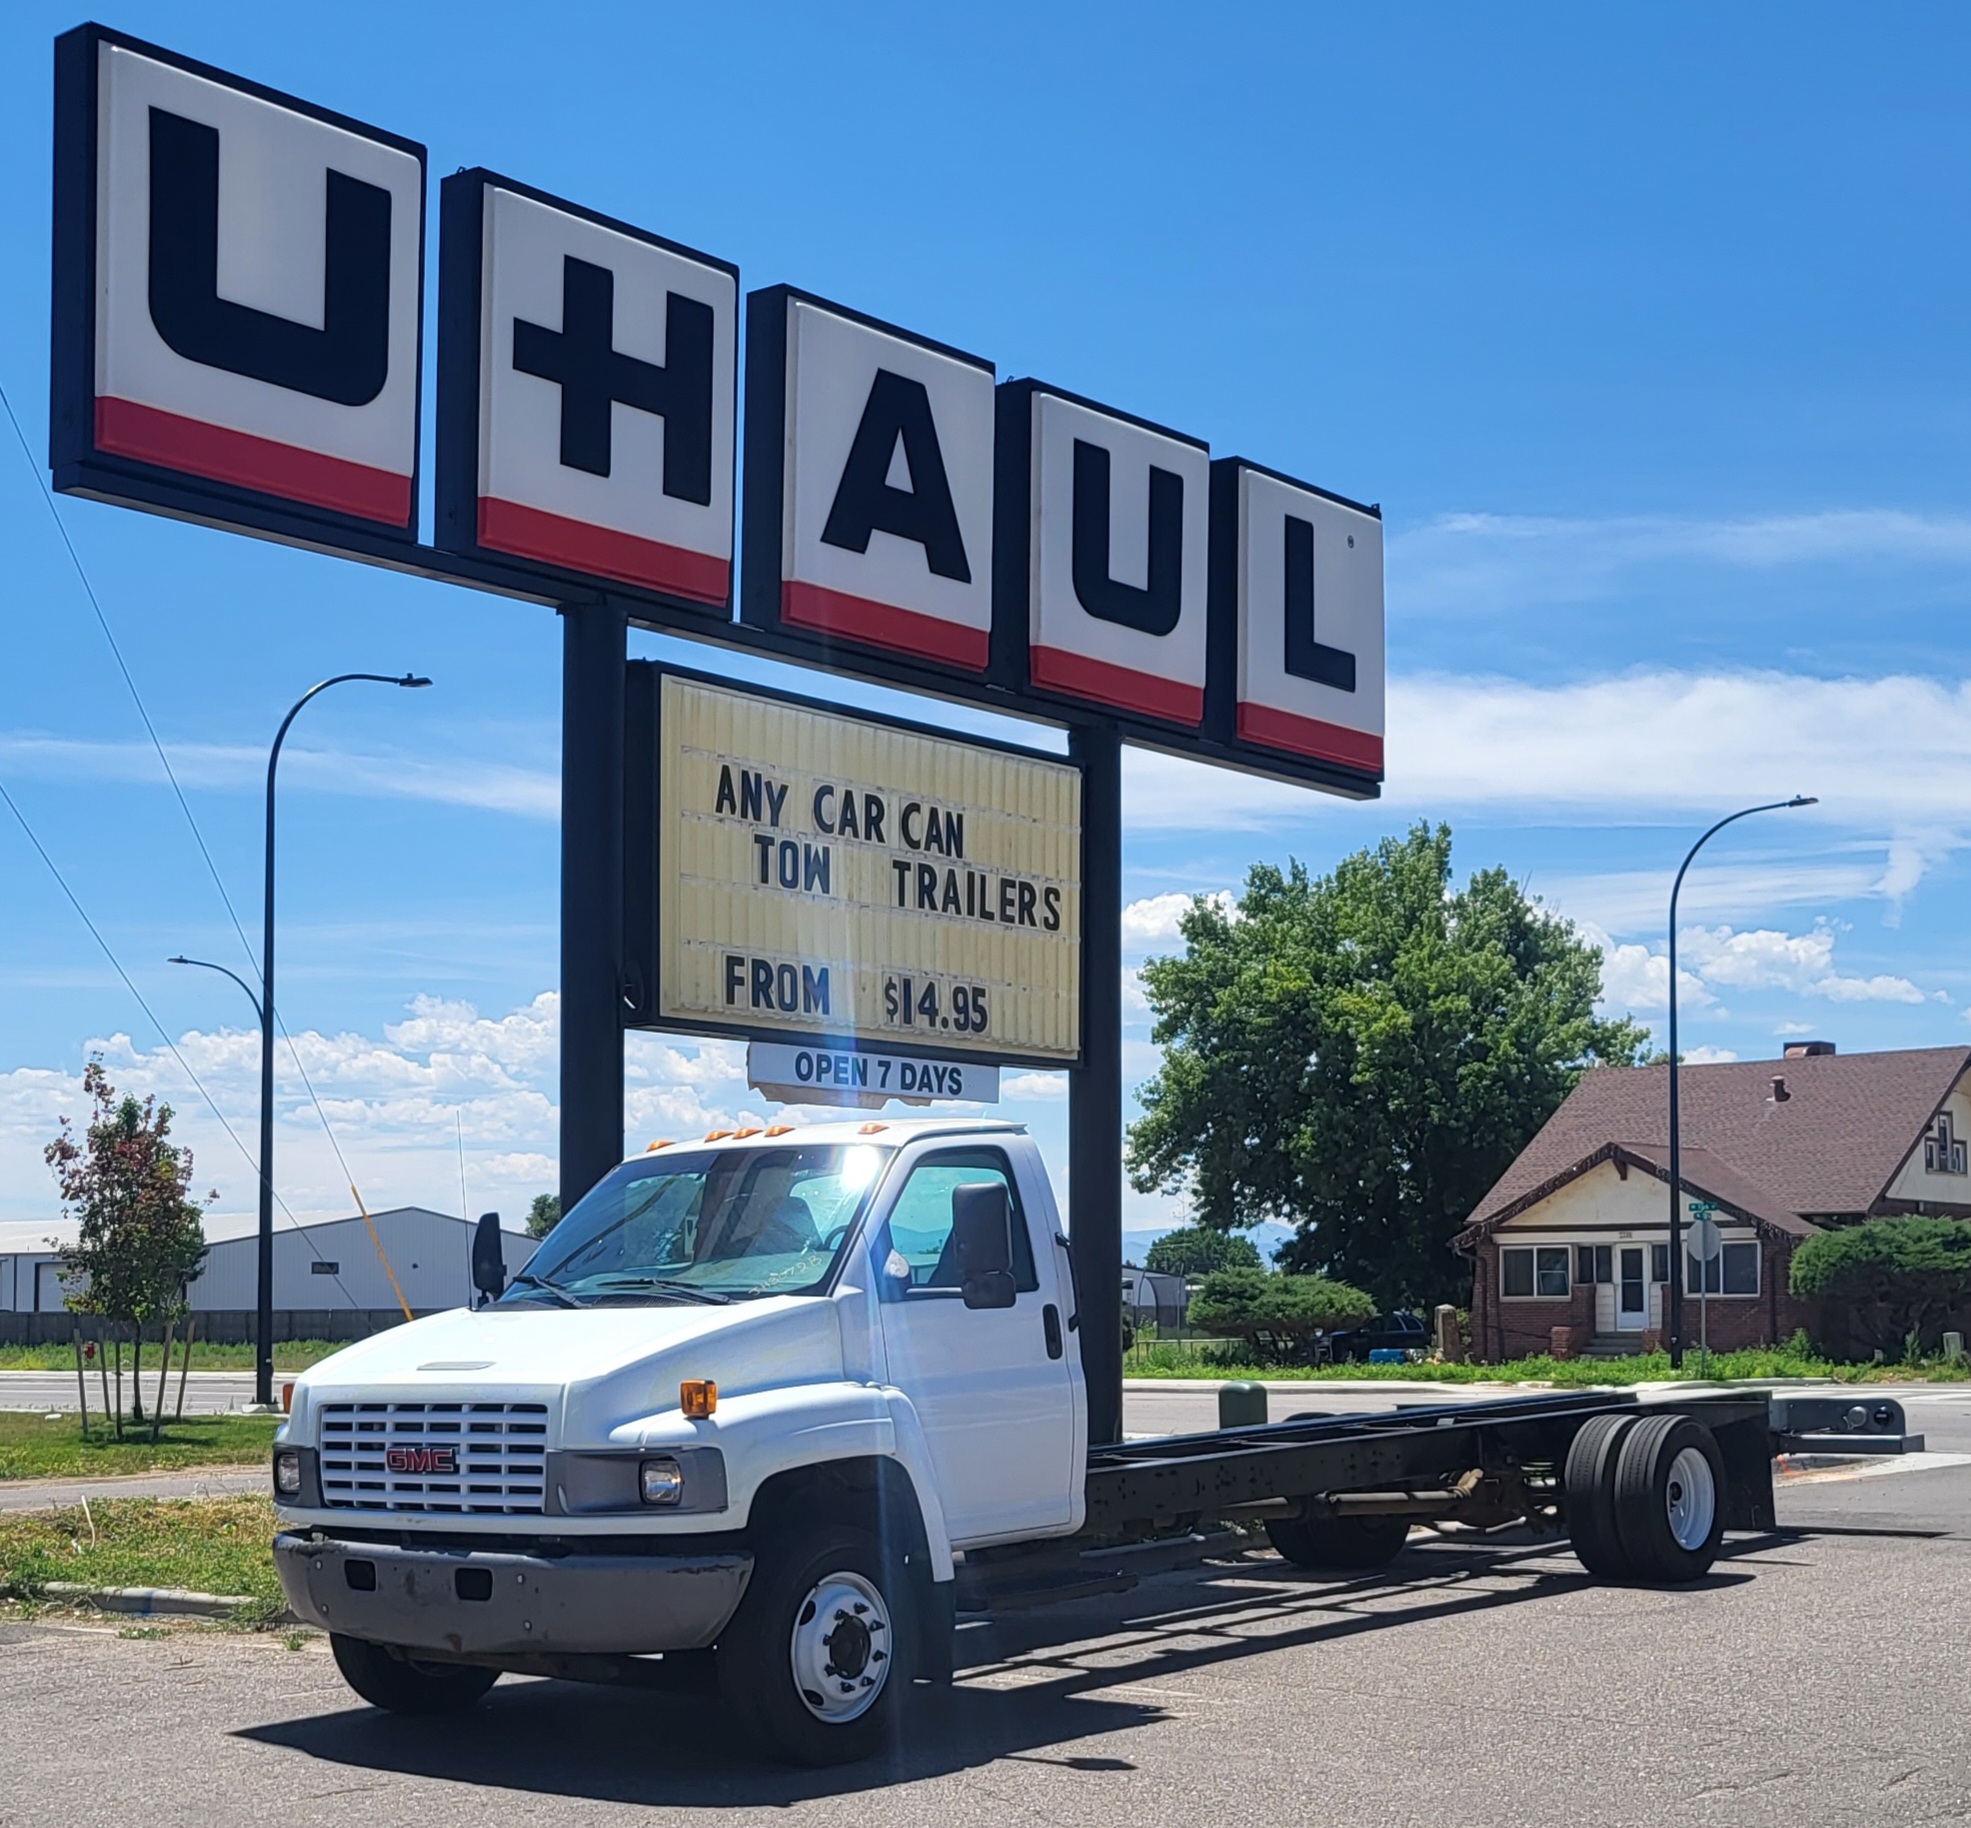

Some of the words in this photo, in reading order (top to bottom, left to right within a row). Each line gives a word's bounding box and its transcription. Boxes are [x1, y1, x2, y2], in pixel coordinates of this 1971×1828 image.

[715, 764, 789, 827] ANY
[813, 784, 886, 843] CAR
[901, 802, 964, 859] CAN
[754, 833, 830, 894] TOW
[892, 859, 1061, 931] TRAILERS
[725, 955, 830, 1016] FROM
[884, 976, 988, 1033] $14.95
[795, 1051, 868, 1087] OPEN
[877, 1060, 891, 1088] 7
[901, 1062, 962, 1095] DAYS
[386, 1448, 454, 1472] GMC
